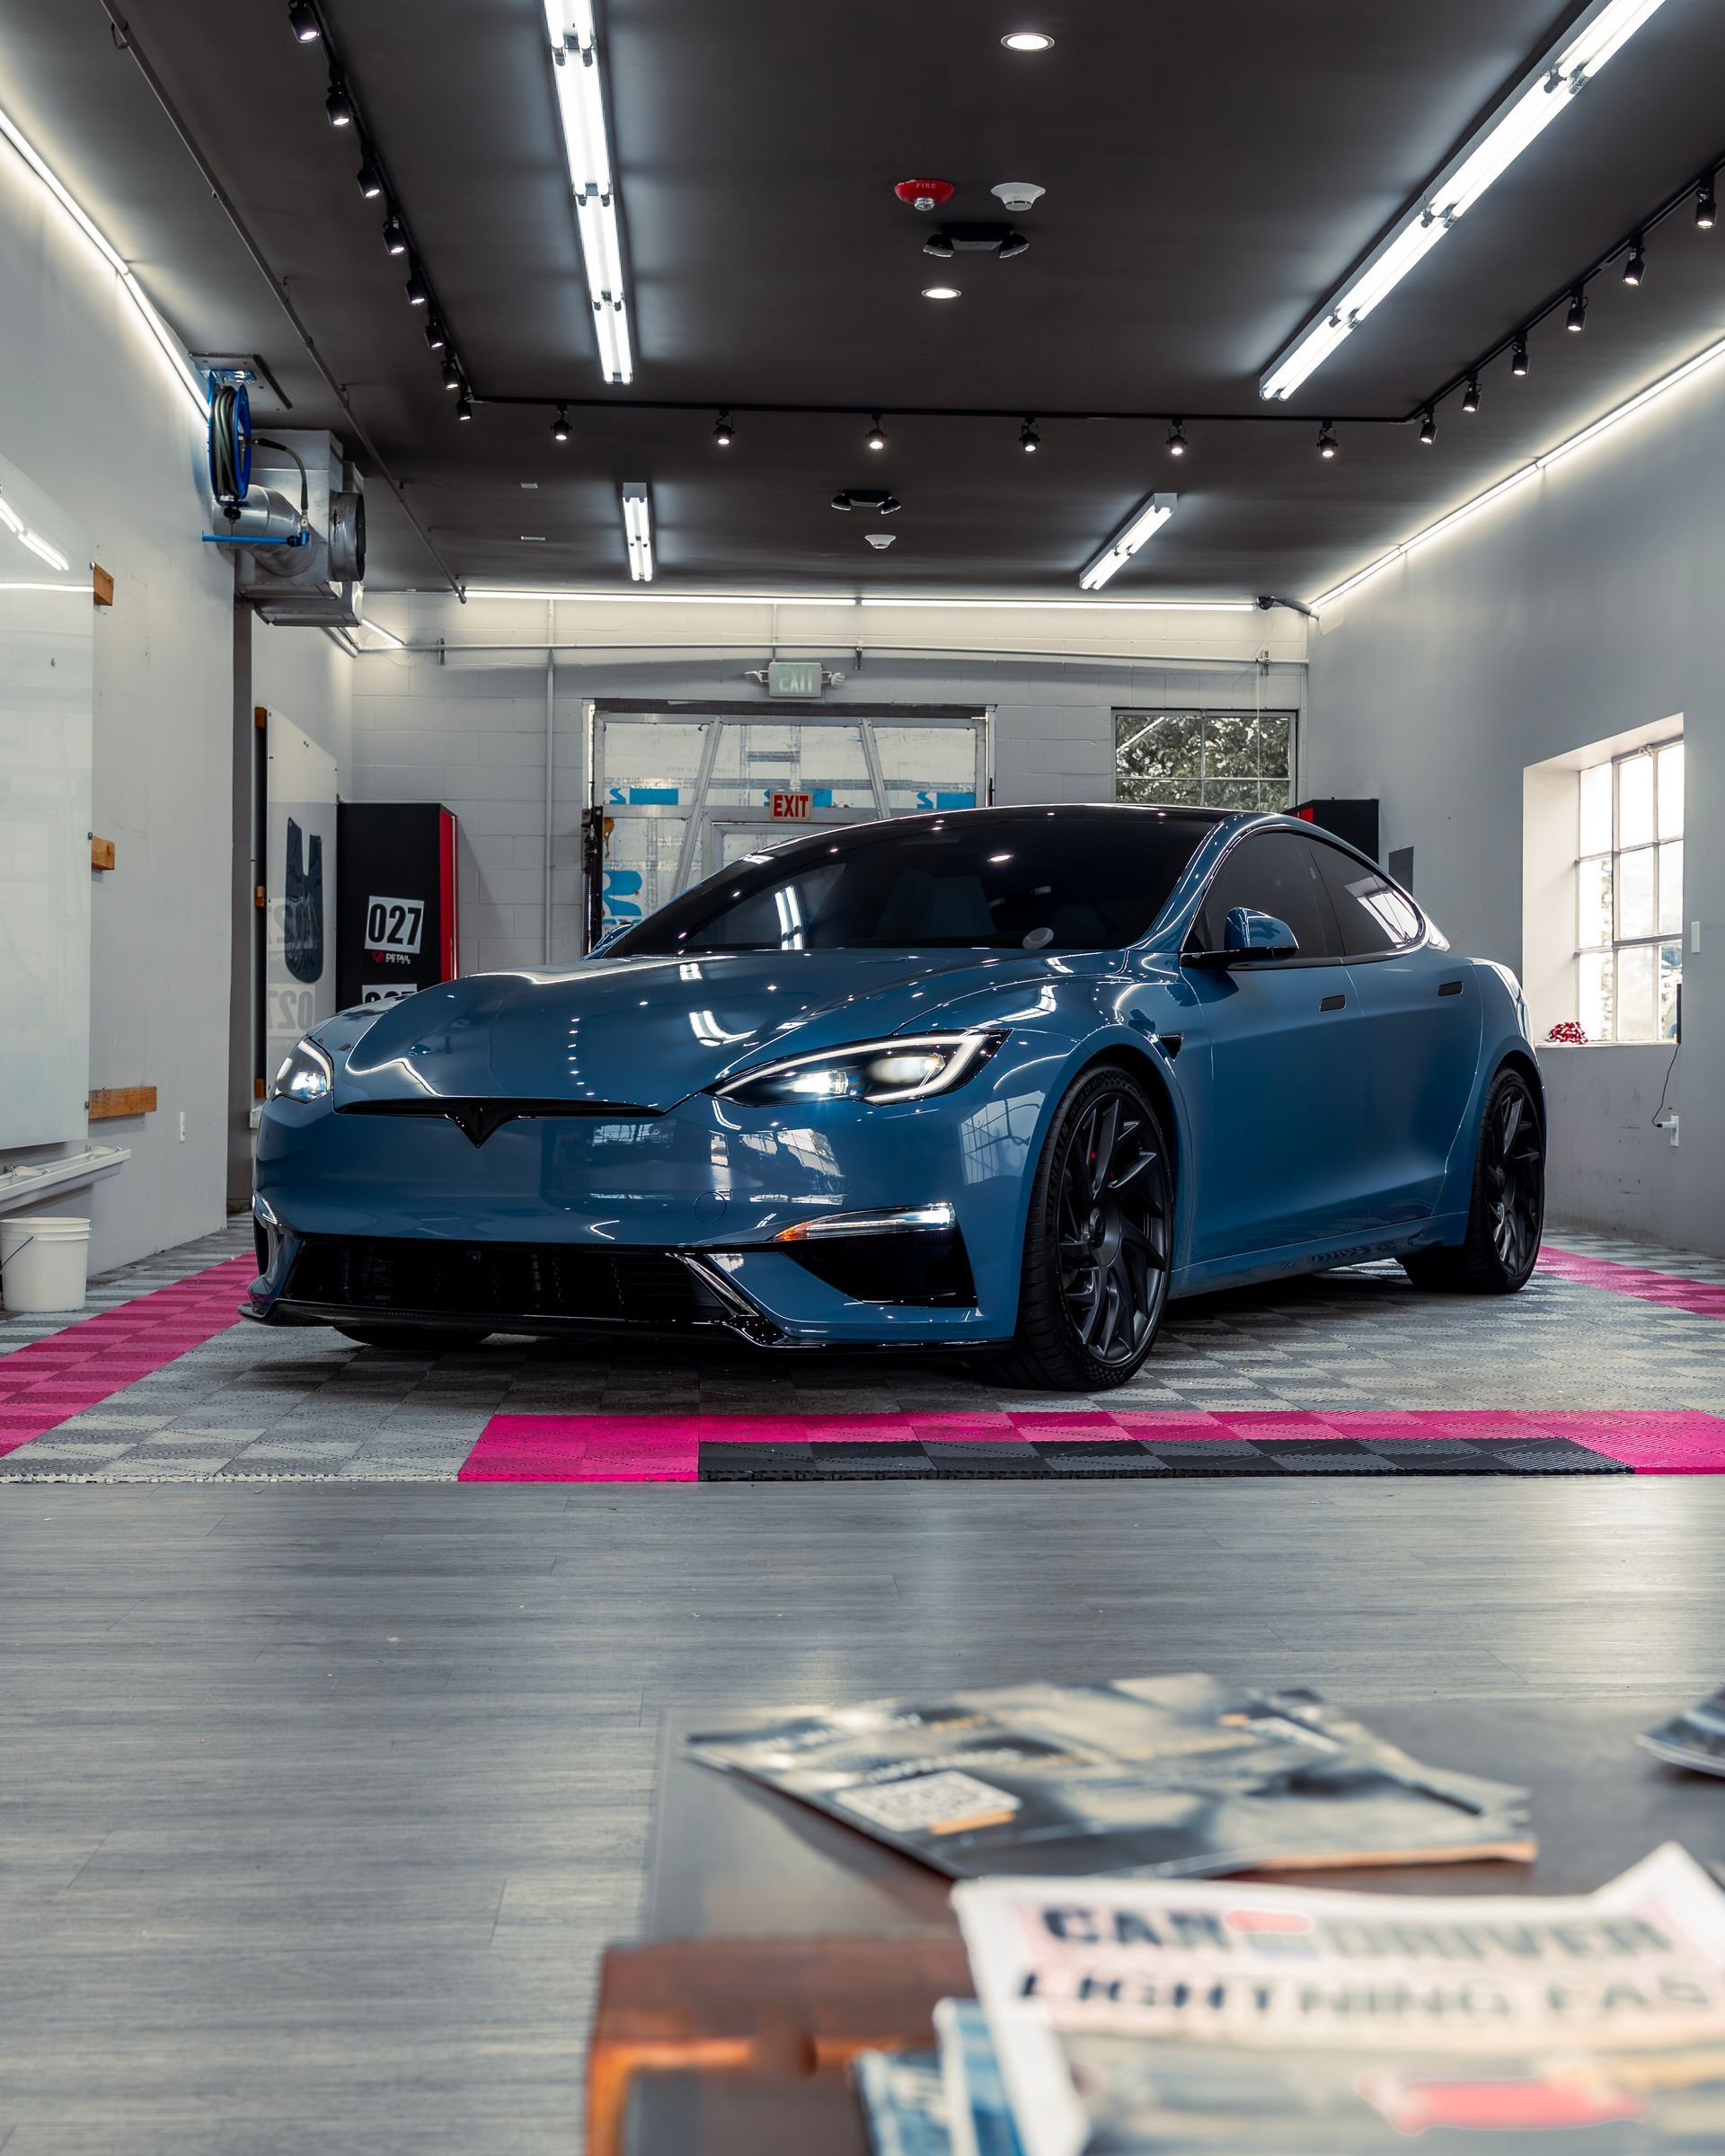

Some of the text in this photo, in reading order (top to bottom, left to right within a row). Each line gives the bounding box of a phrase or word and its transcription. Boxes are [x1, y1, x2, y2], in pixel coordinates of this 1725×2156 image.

[778, 664, 813, 692] EXIT
[774, 794, 809, 817] EXIT
[368, 903, 422, 946] 027
[385, 952, 410, 961] DETAIL
[1042, 1906, 1231, 1949] CAR
